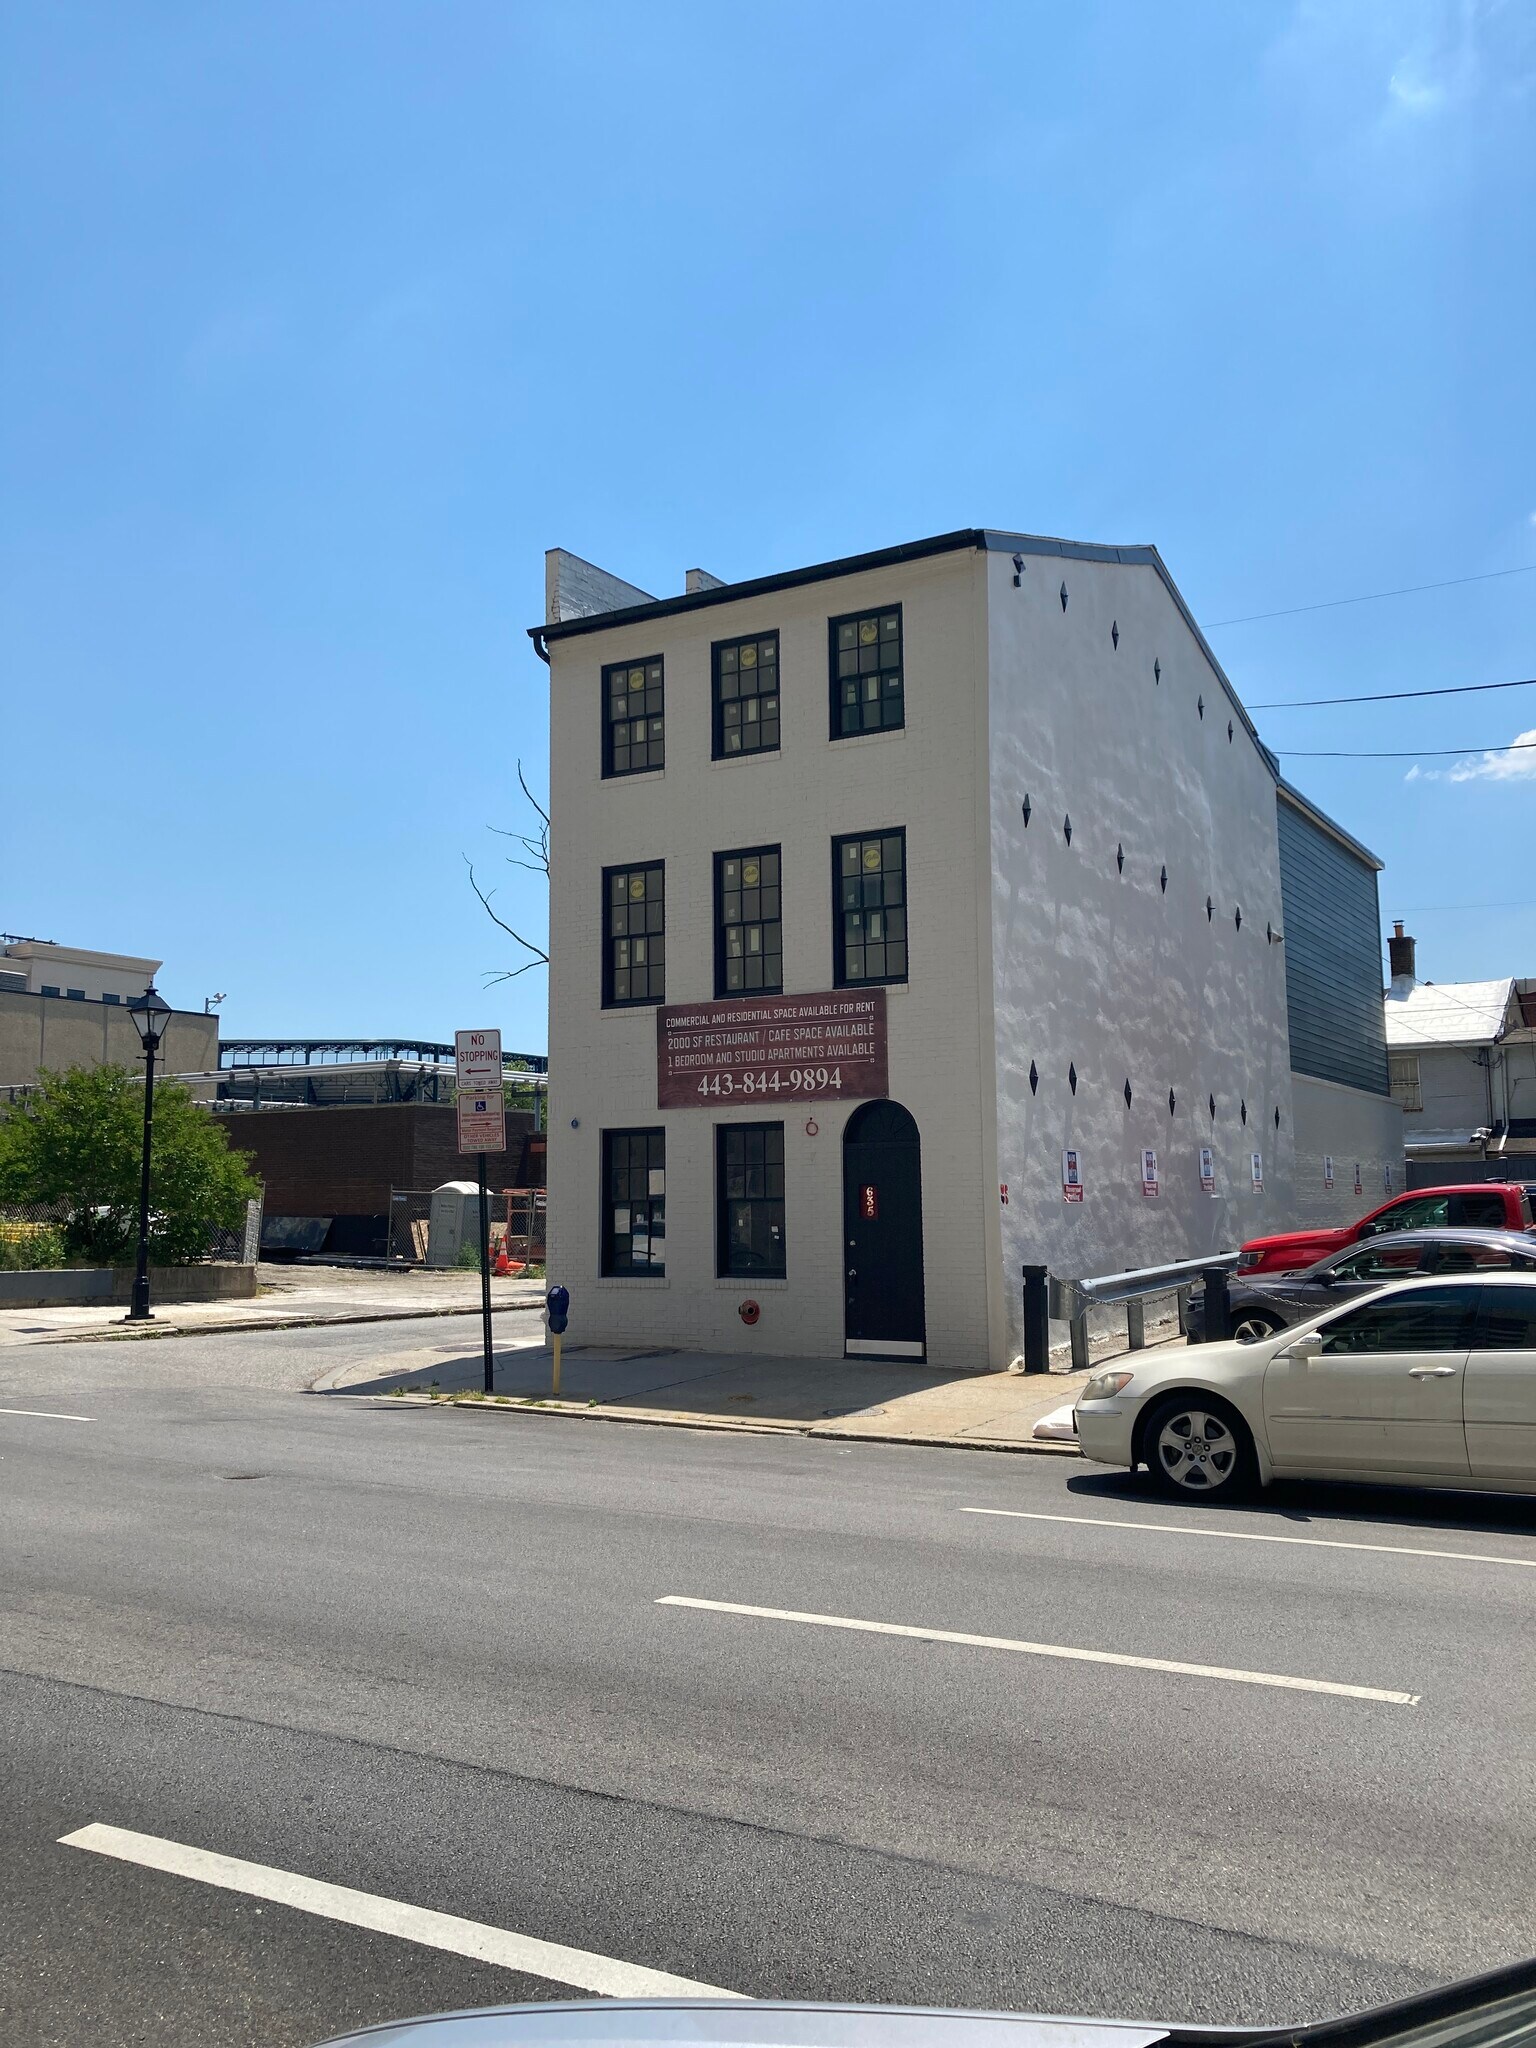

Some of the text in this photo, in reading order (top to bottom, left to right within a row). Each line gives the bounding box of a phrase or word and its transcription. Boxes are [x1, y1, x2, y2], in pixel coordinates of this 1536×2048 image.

[666, 1001, 875, 1028] COMMERCIAL AND RESIDENTIAL SPACE AVAILABLE FOR RENT
[471, 1034, 485, 1046] NO
[668, 1023, 875, 1050] 2000 SF RESTAURANT / CAFE SPACE AVAILABLE
[459, 1050, 498, 1062] STOPPING
[668, 1042, 875, 1068] 1 BEDROOM AND STUDIO APARTMENTS AVAILABLE
[697, 1066, 842, 1096] 443-844-9894
[865, 1186, 875, 1217] 635
